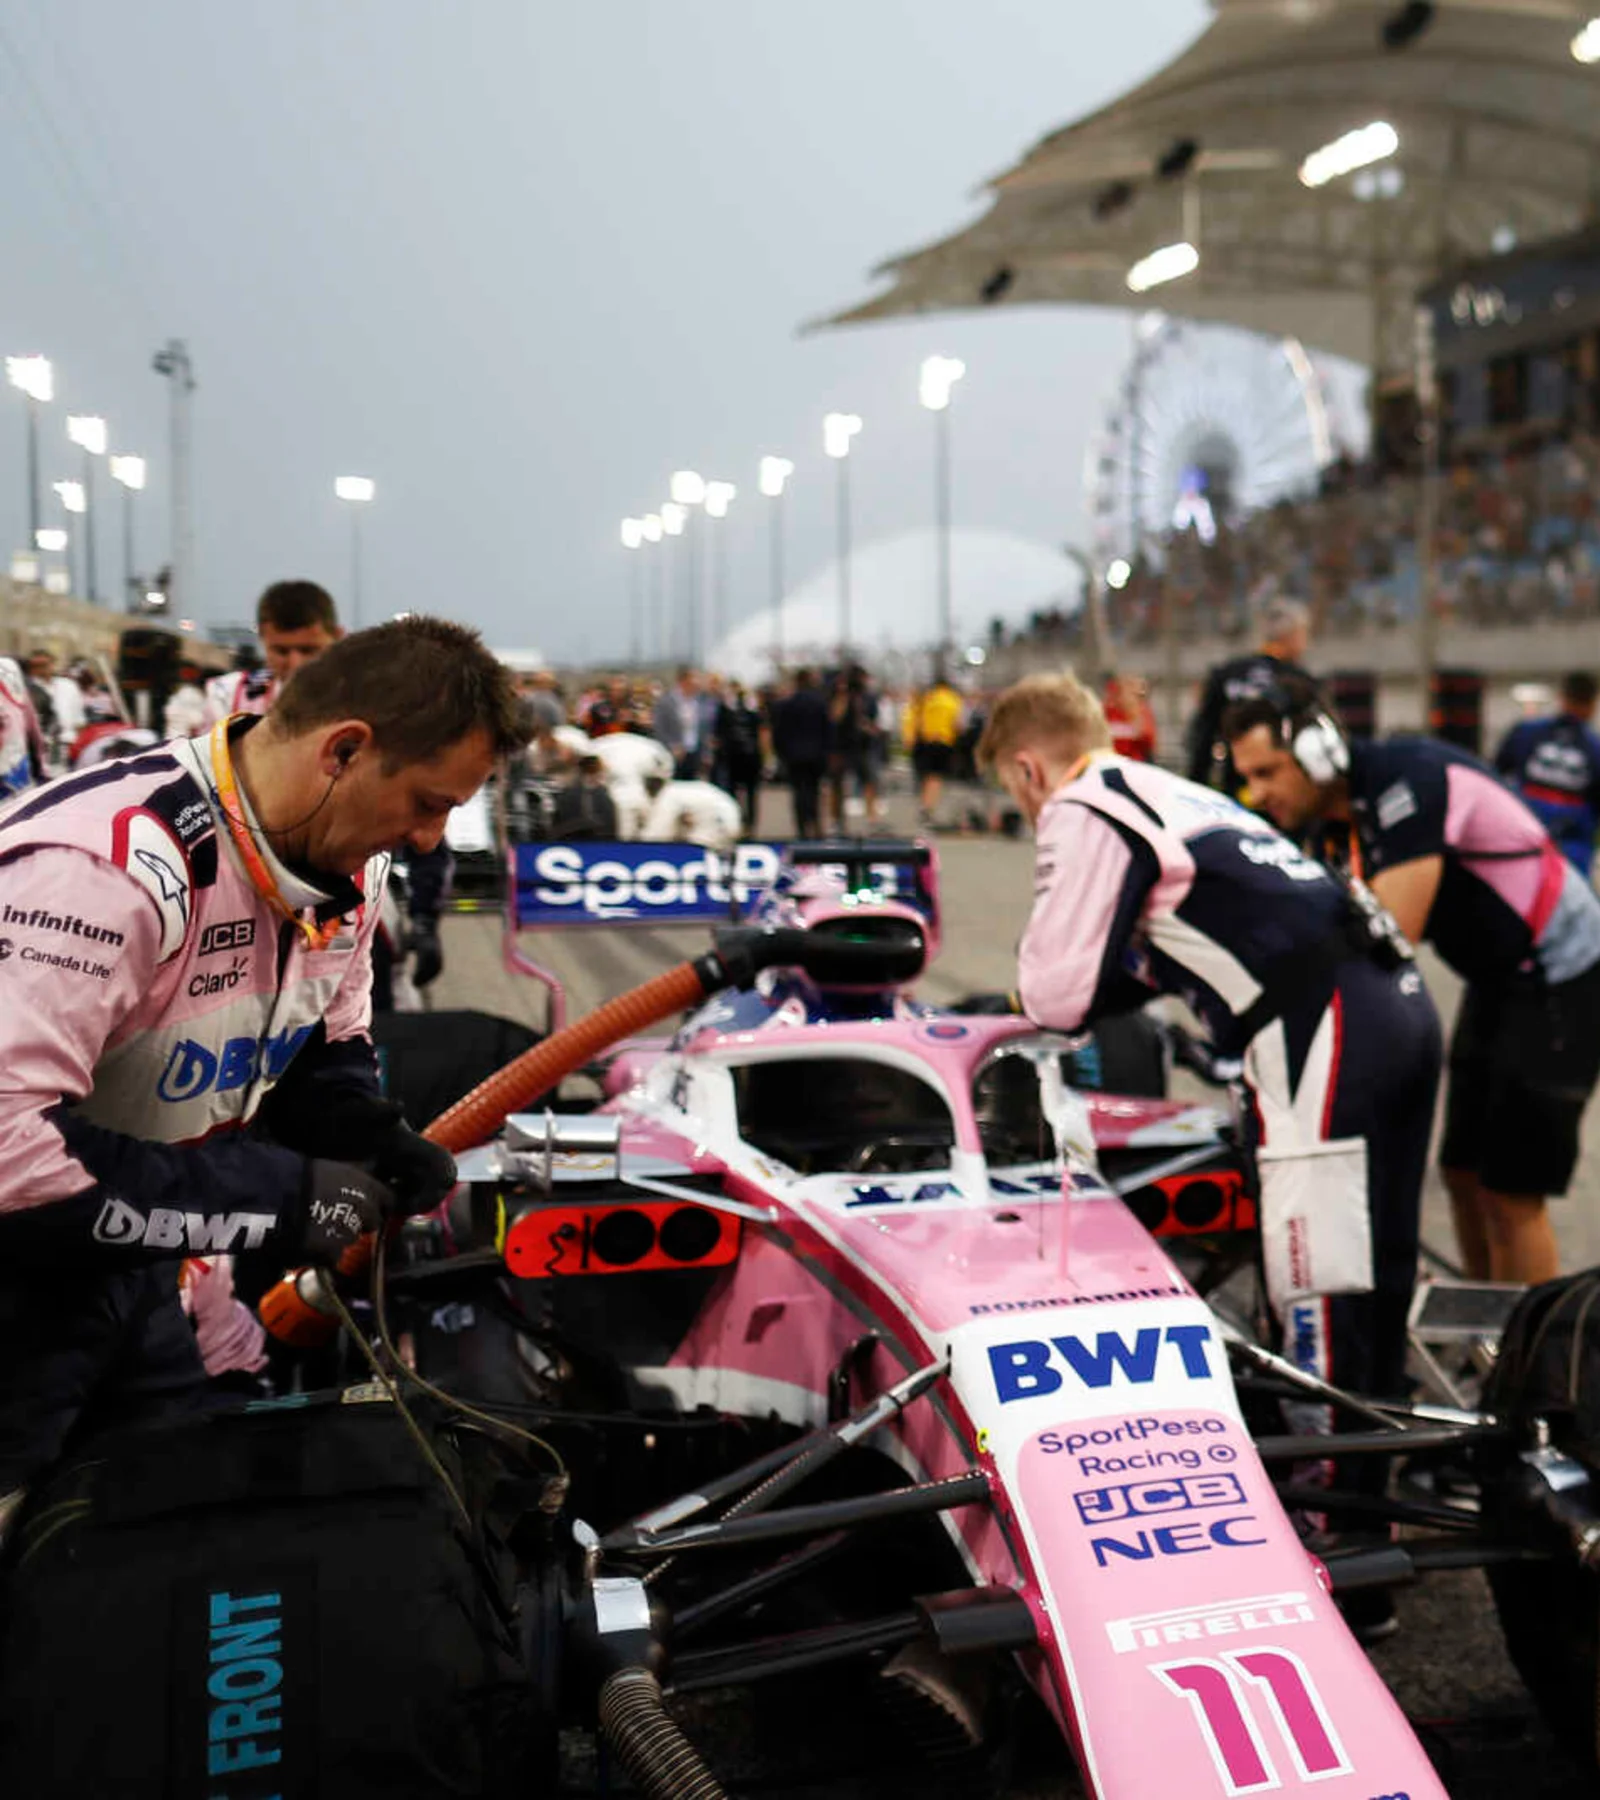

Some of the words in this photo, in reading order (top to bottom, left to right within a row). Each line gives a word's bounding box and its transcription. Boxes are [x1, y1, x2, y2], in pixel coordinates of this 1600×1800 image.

[2, 905, 125, 947] infinitum
[200, 920, 254, 954] JCB
[19, 946, 80, 971] Canada
[82, 959, 111, 980] Life
[188, 970, 240, 998] Claro
[215, 1024, 315, 1092] BW
[142, 1208, 277, 1250] BWT
[987, 1325, 1213, 1405] BWT
[1038, 1418, 1226, 1455] SportPesa
[1078, 1448, 1201, 1477] Racing
[1076, 1475, 1244, 1523] JCB
[1091, 1516, 1267, 1567] NEC
[1105, 1591, 1315, 1654] PIRELLI
[208, 1591, 284, 1777] FRONT
[1146, 1645, 1355, 1798] 11
